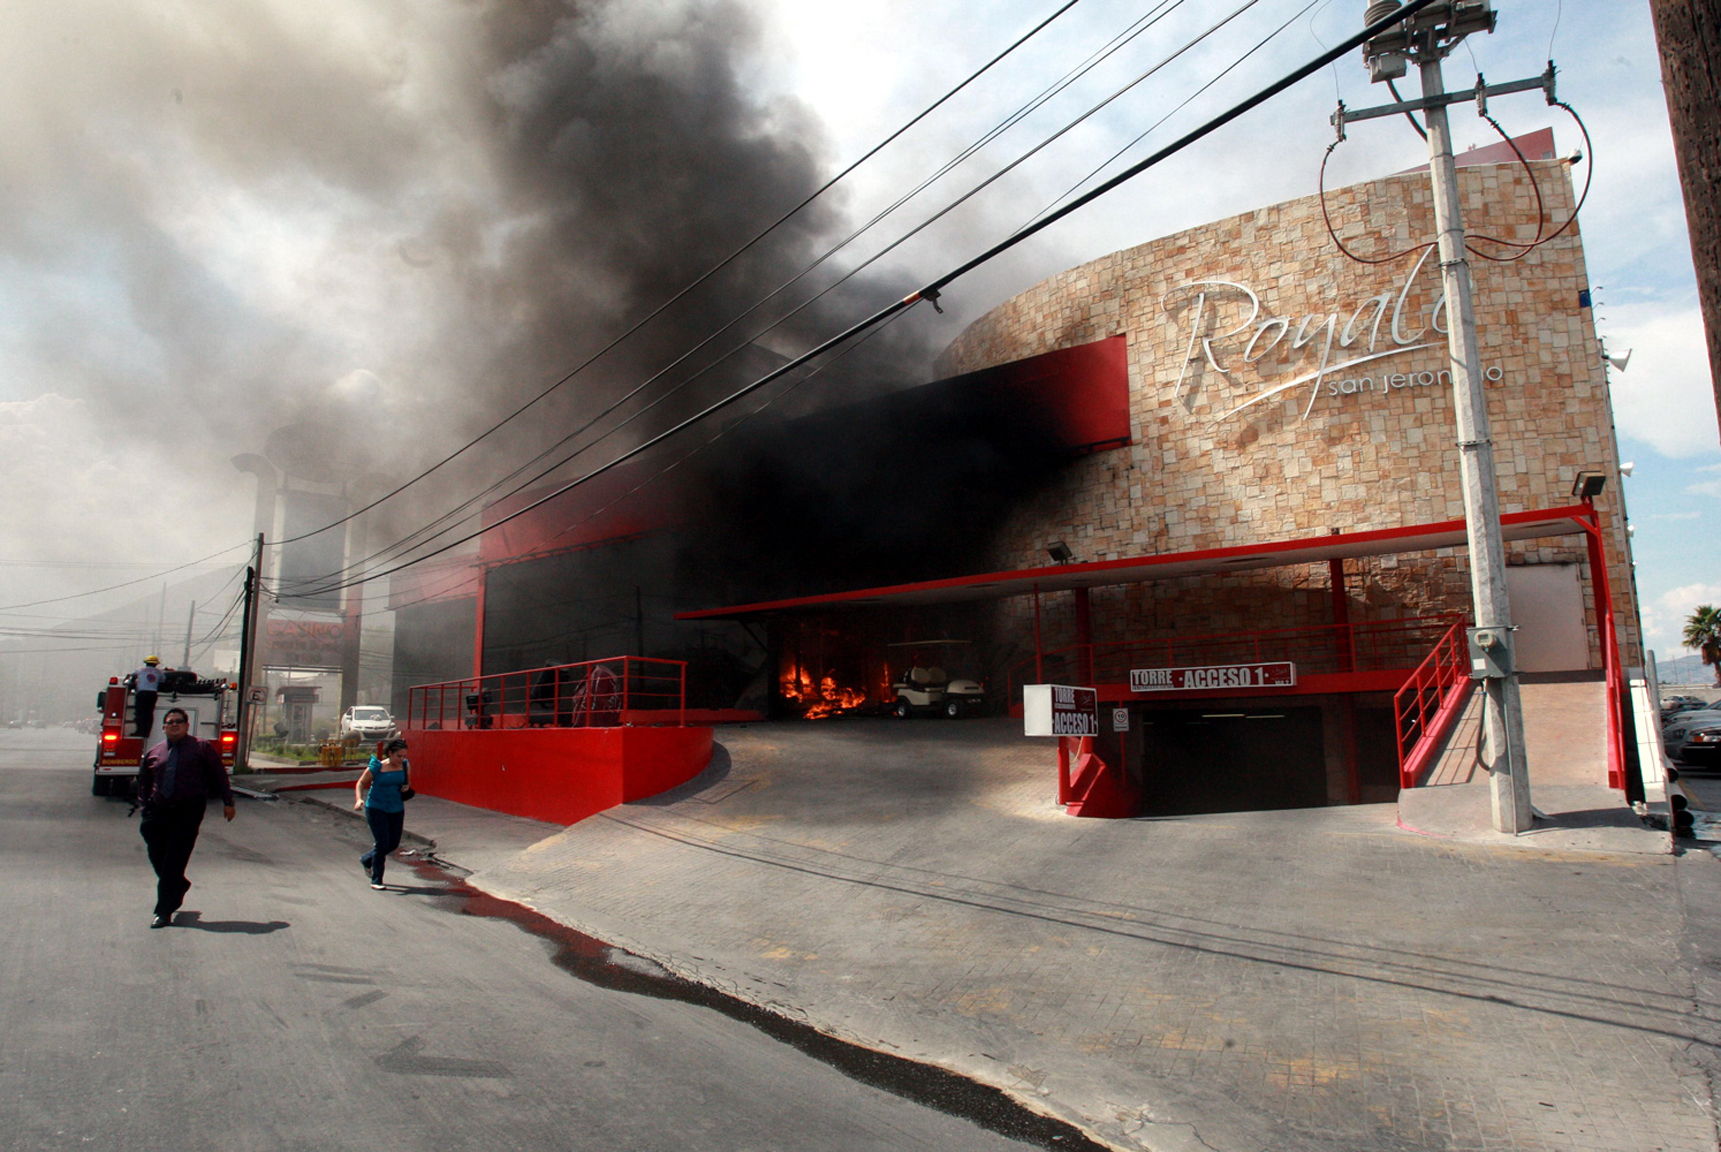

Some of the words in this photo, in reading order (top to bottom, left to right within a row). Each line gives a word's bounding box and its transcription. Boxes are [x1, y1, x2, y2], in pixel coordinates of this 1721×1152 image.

[1329, 373, 1375, 396] san
[1383, 365, 1503, 394] jerono
[1133, 670, 1173, 685] TORRE
[1183, 667, 1252, 688] ACCESO
[1254, 666, 1264, 686] 1
[1054, 687, 1075, 703] TORRE
[1054, 712, 1089, 733] ACCESO
[1089, 713, 1095, 734] 1
